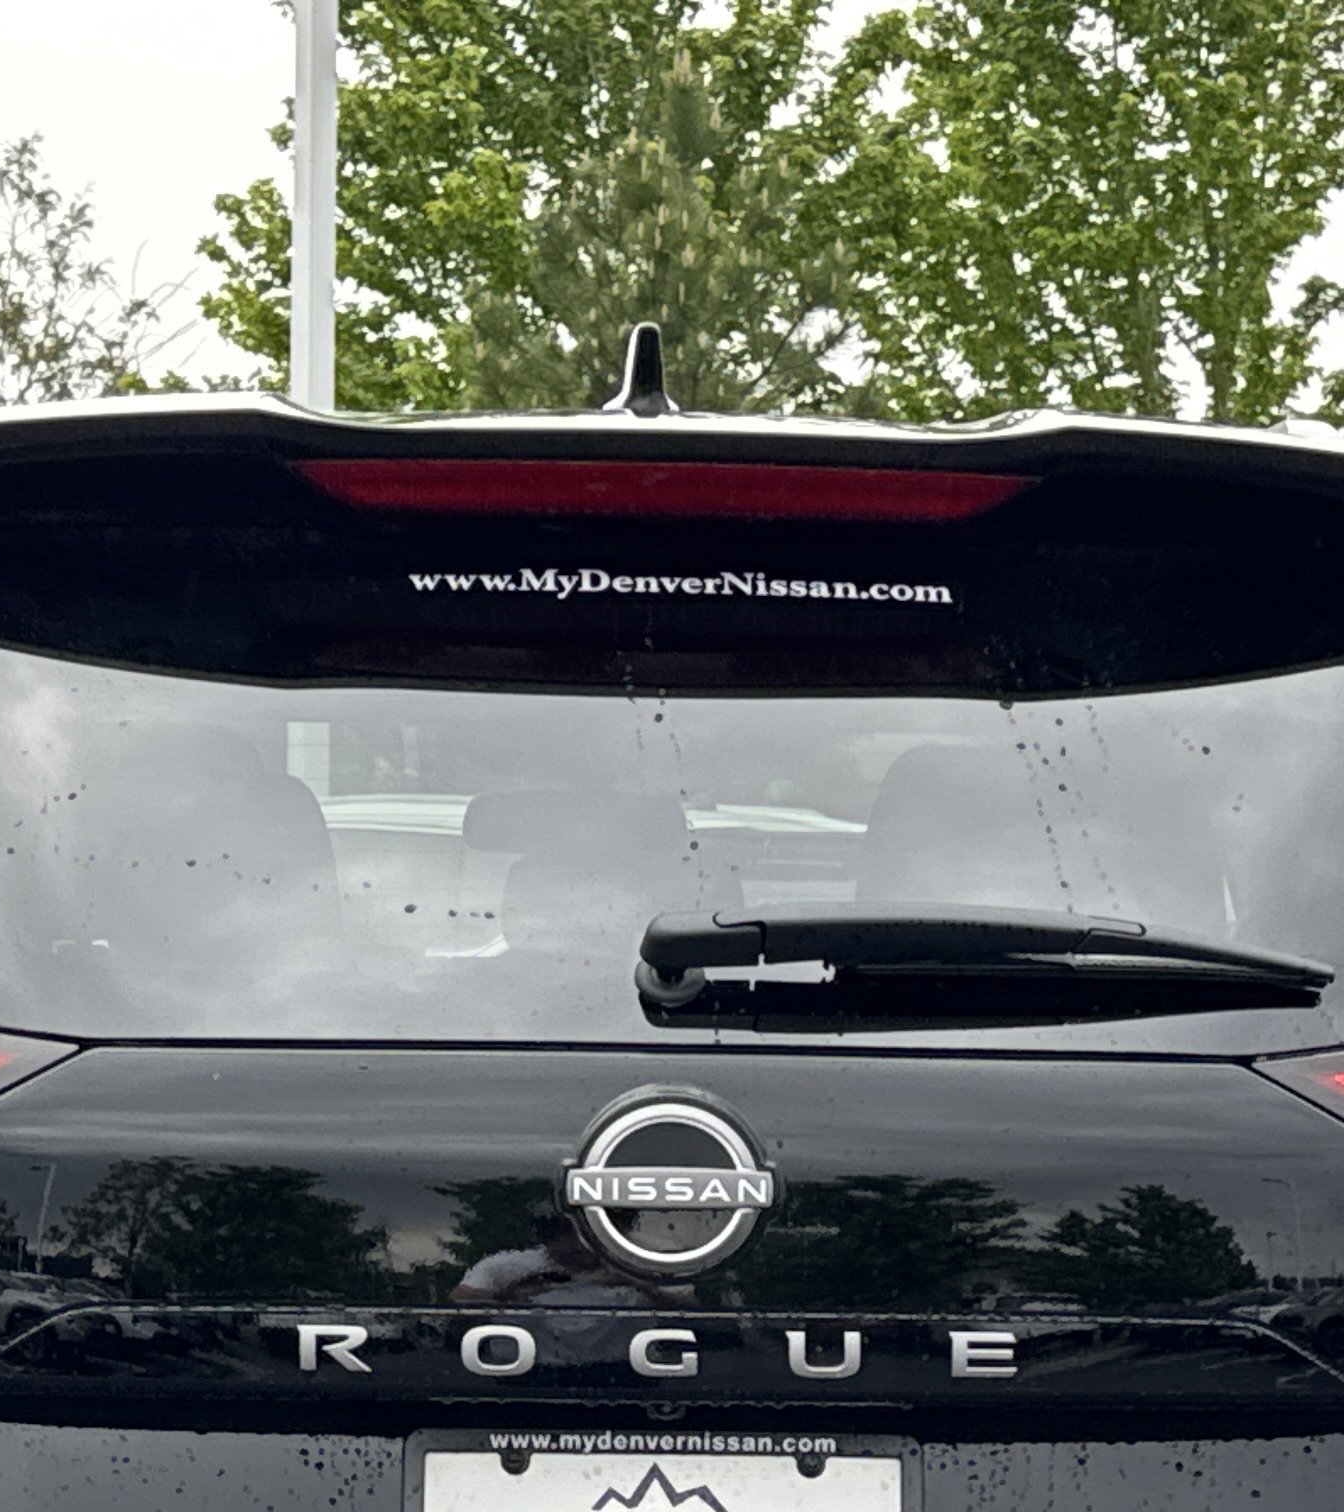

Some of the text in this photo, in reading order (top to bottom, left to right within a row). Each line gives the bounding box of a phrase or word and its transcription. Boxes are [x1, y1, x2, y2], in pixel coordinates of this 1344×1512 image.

[408, 567, 954, 604] www.MyDenverNissan.com
[572, 1176, 768, 1204] NISSAN
[296, 1323, 1019, 1378] ROGUE
[489, 1430, 837, 1454] www.mydenvernissan.com
